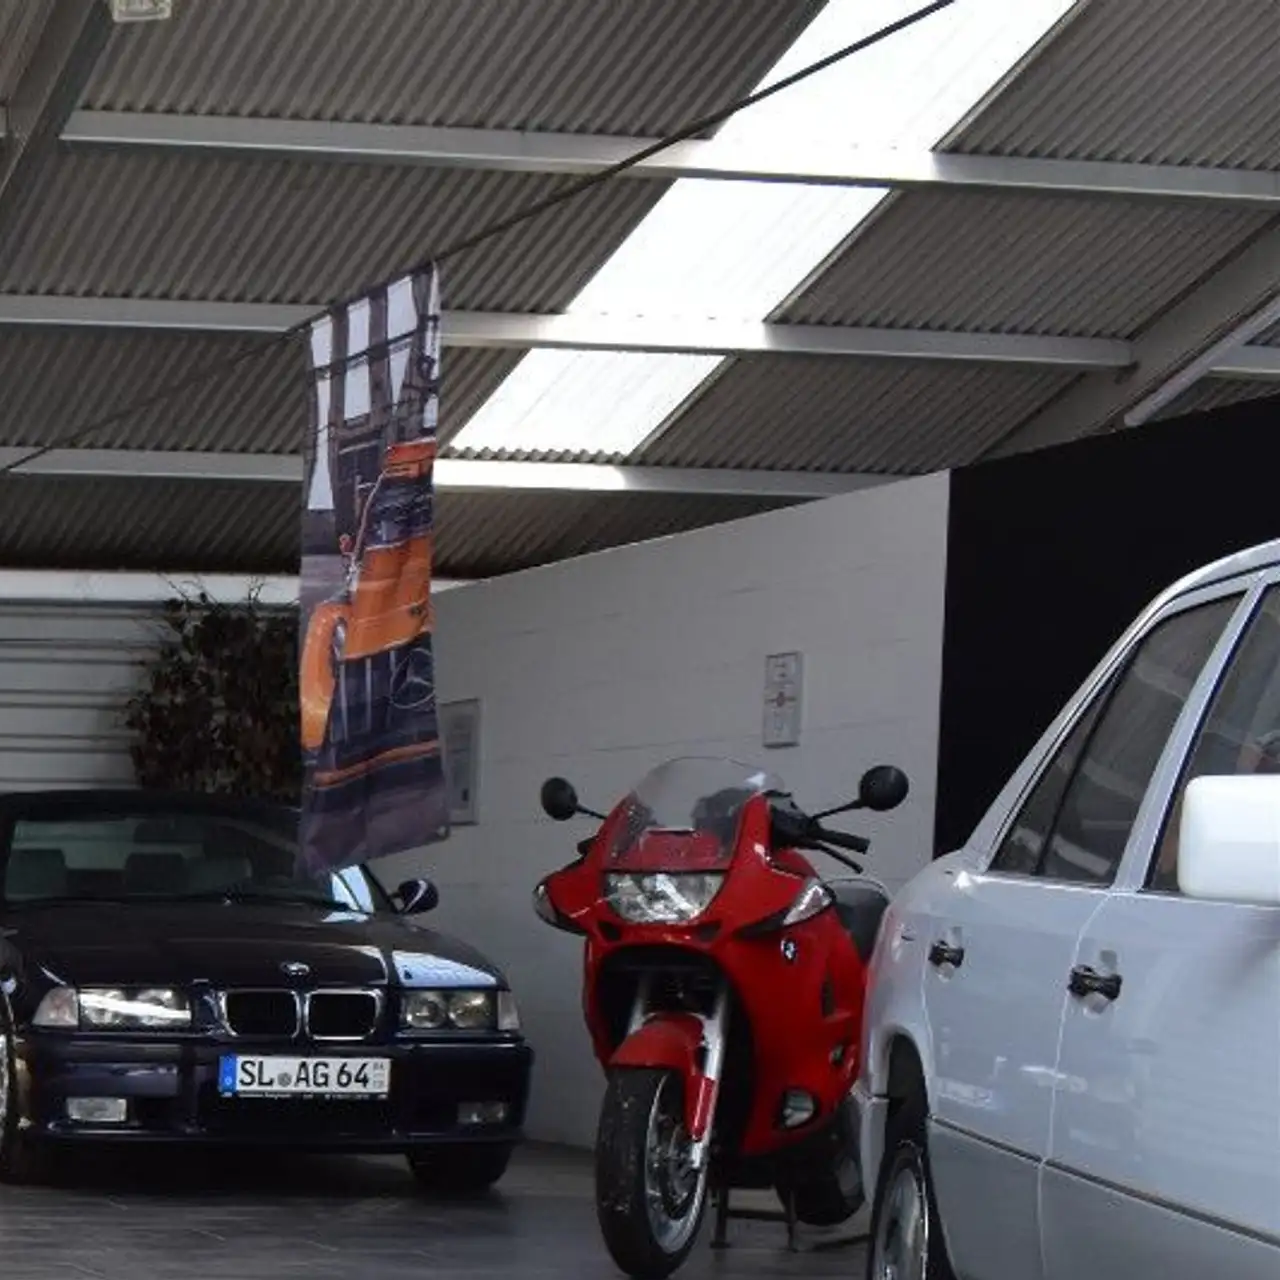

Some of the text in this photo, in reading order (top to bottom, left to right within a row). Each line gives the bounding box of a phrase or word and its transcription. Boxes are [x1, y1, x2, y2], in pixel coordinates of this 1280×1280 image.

[239, 1060, 274, 1087] SL
[295, 1061, 330, 1088] AG
[337, 1062, 369, 1088] 64
